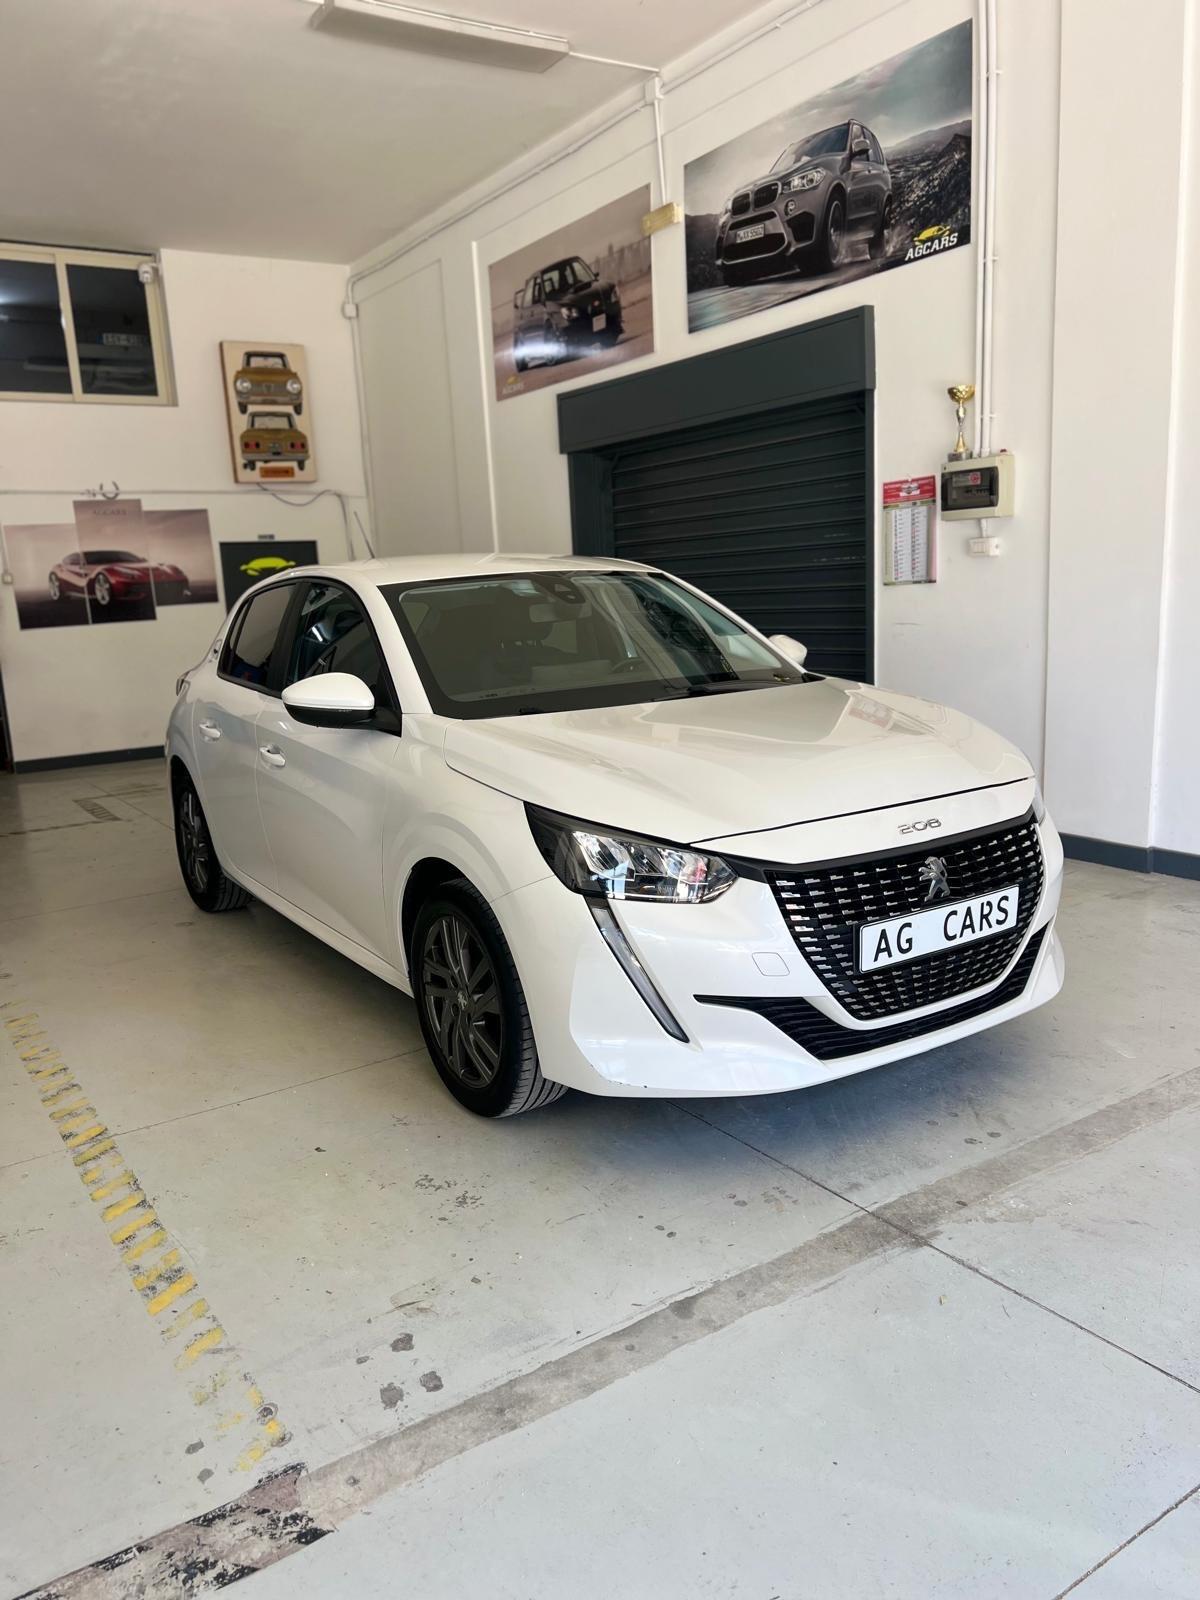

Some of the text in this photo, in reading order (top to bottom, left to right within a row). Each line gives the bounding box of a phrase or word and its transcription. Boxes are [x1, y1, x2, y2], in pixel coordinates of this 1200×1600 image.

[904, 232, 959, 261] AGCARS
[897, 817, 942, 835] 208
[873, 895, 1009, 963] AG CARS
